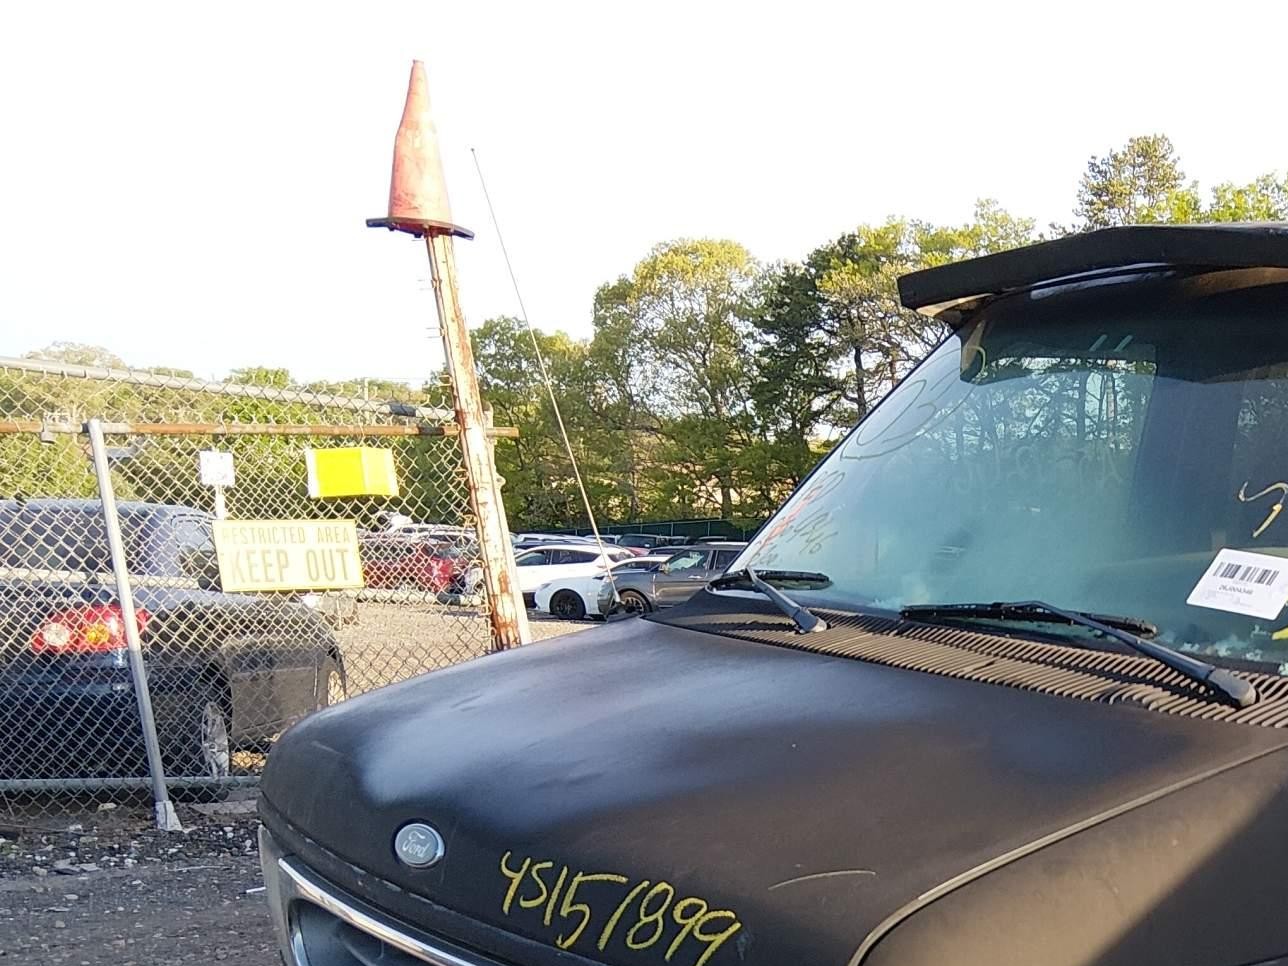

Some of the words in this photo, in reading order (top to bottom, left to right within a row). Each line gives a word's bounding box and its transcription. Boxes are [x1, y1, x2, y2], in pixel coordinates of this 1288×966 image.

[222, 526, 306, 545] RESTRICTED
[317, 526, 351, 544] AREA
[231, 549, 289, 584] KEEP
[305, 549, 349, 582] OUT
[402, 830, 432, 858] Ford
